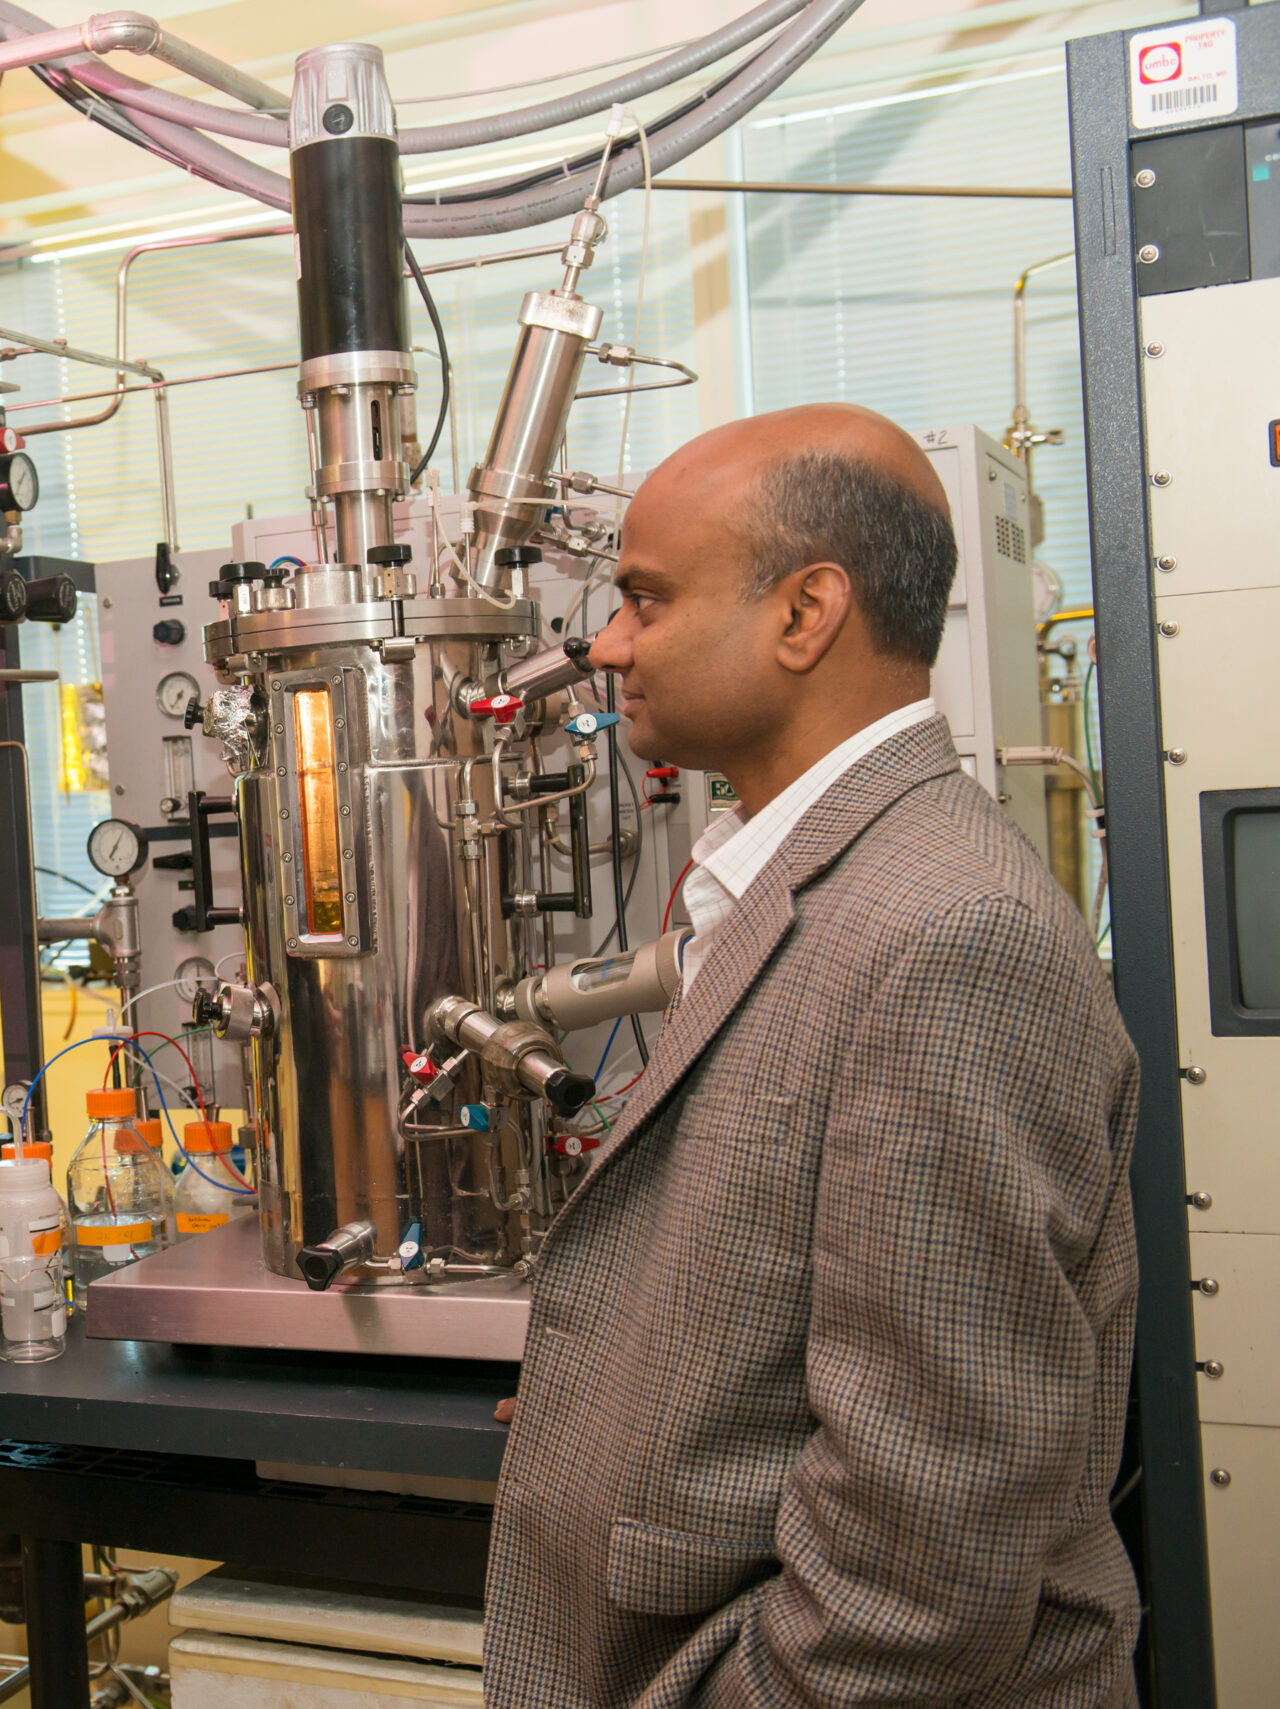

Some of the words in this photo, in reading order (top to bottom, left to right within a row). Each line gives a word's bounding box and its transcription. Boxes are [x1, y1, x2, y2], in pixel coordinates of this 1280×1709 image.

[1184, 29, 1226, 42] PROPERTY
[1198, 40, 1214, 48] TAG
[1144, 53, 1177, 70] umbc
[923, 429, 949, 445] #2
